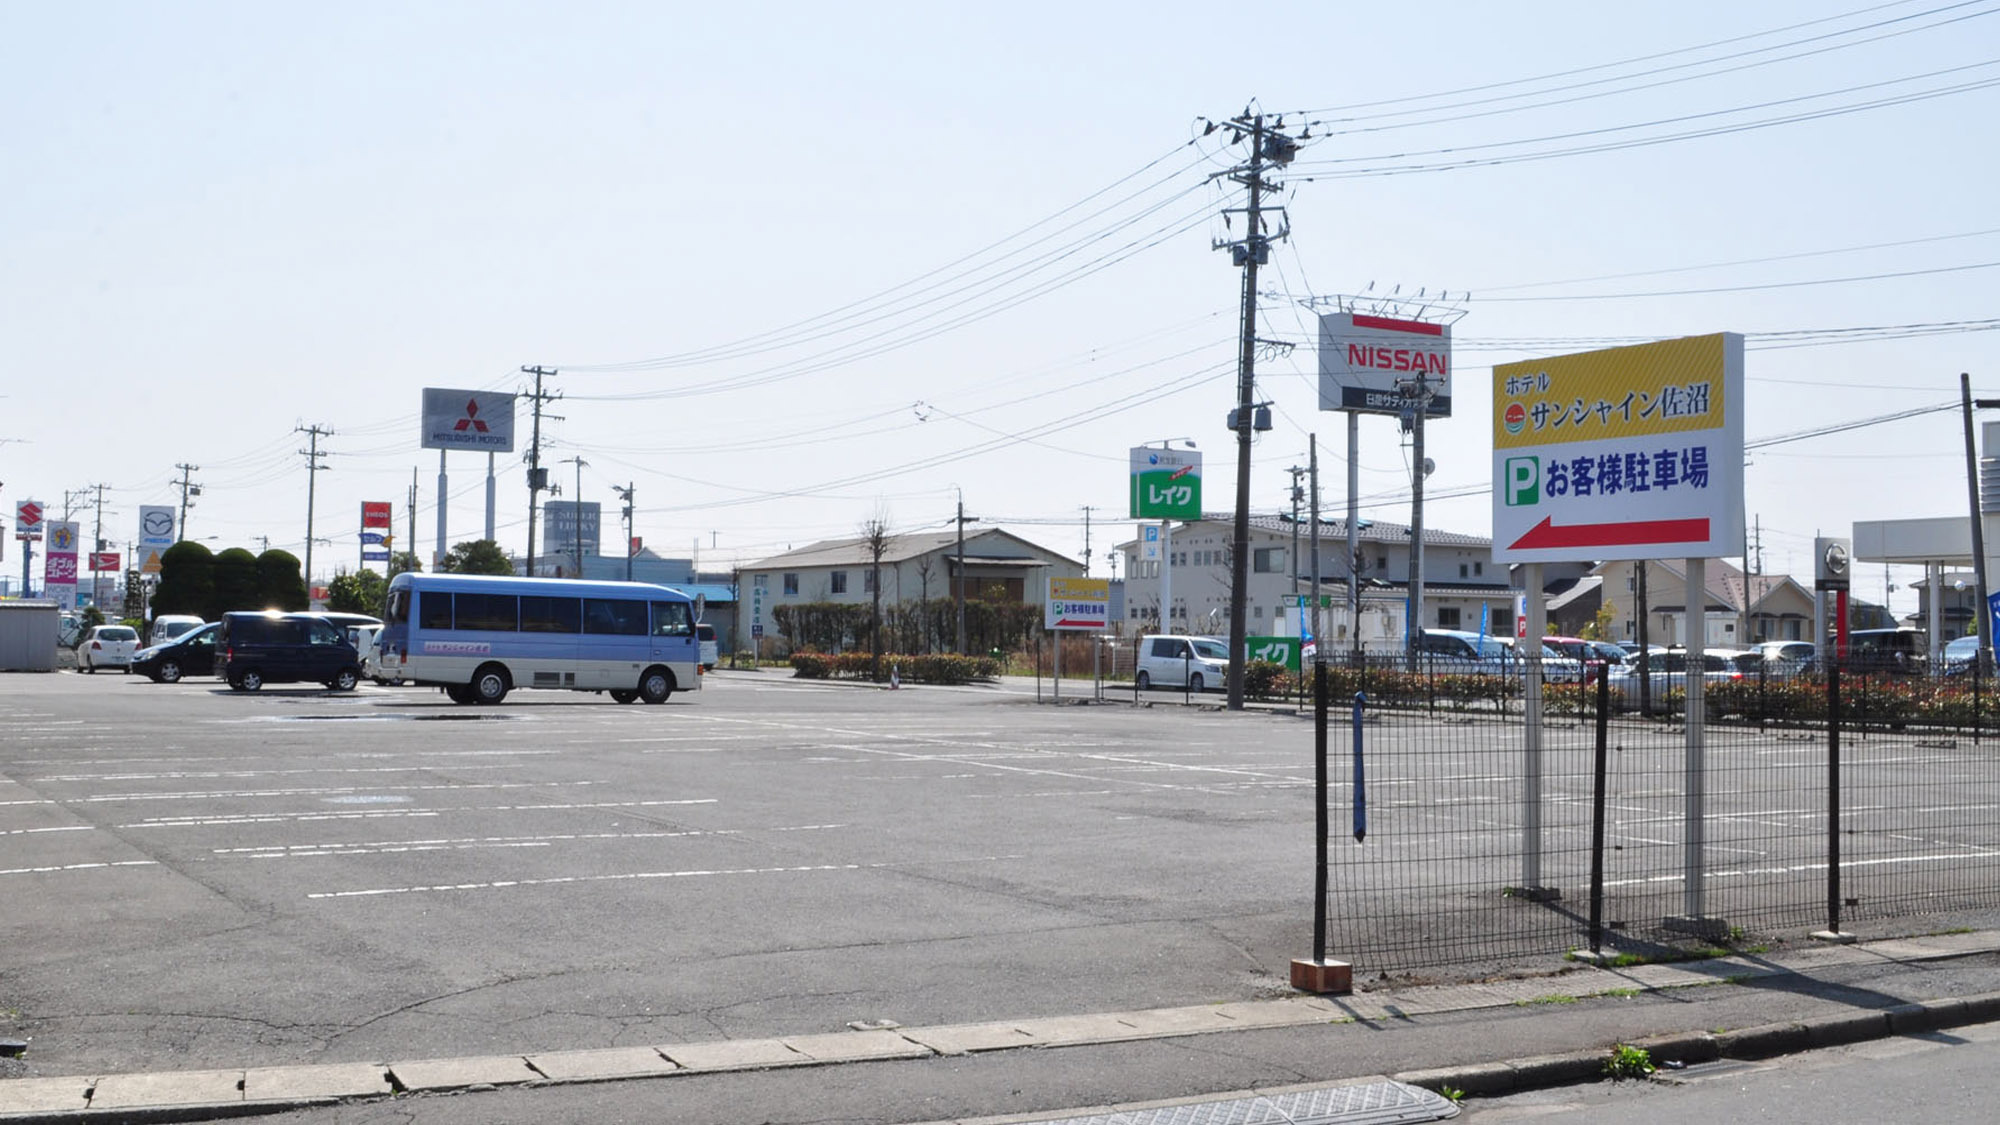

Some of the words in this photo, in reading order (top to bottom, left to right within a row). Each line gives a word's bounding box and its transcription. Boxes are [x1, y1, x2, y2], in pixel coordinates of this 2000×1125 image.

[1348, 343, 1446, 375] NISSAN
[1506, 372, 1550, 395] ホテル
[1365, 392, 1429, 409] 日産サティオ
[1531, 383, 1709, 431] サンシャイン佐沼
[432, 432, 476, 443] MITSUBISHI
[478, 435, 507, 445] MOTORS
[1508, 458, 1539, 505] P
[1546, 446, 1709, 498] お客様駐車場
[1149, 484, 1192, 505] レイク
[47, 557, 76, 569] ダブル
[47, 569, 76, 579] ストーン
